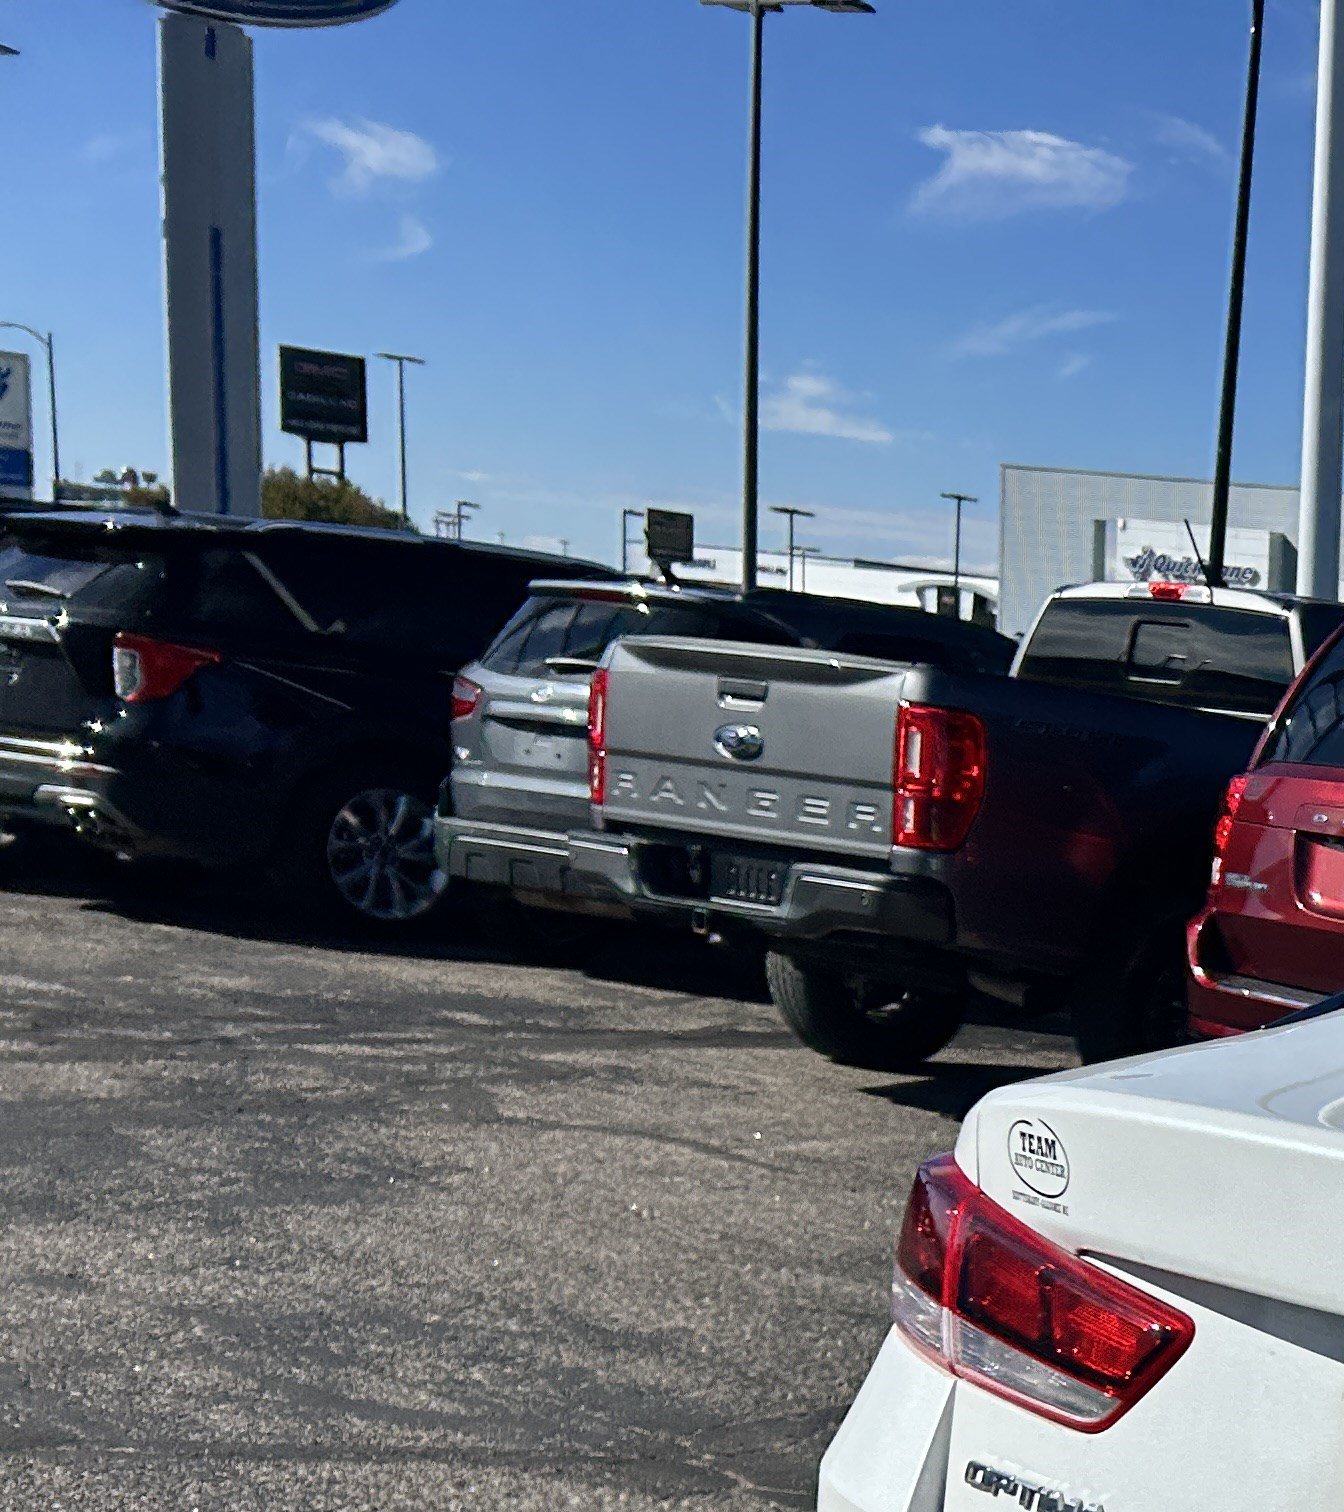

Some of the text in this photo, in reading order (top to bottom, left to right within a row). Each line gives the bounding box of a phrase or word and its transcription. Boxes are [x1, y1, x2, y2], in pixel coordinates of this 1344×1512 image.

[610, 769, 883, 833] RANGER
[1019, 1131, 1058, 1161] TEAM
[1014, 1152, 1067, 1179] AUTO CENTER
